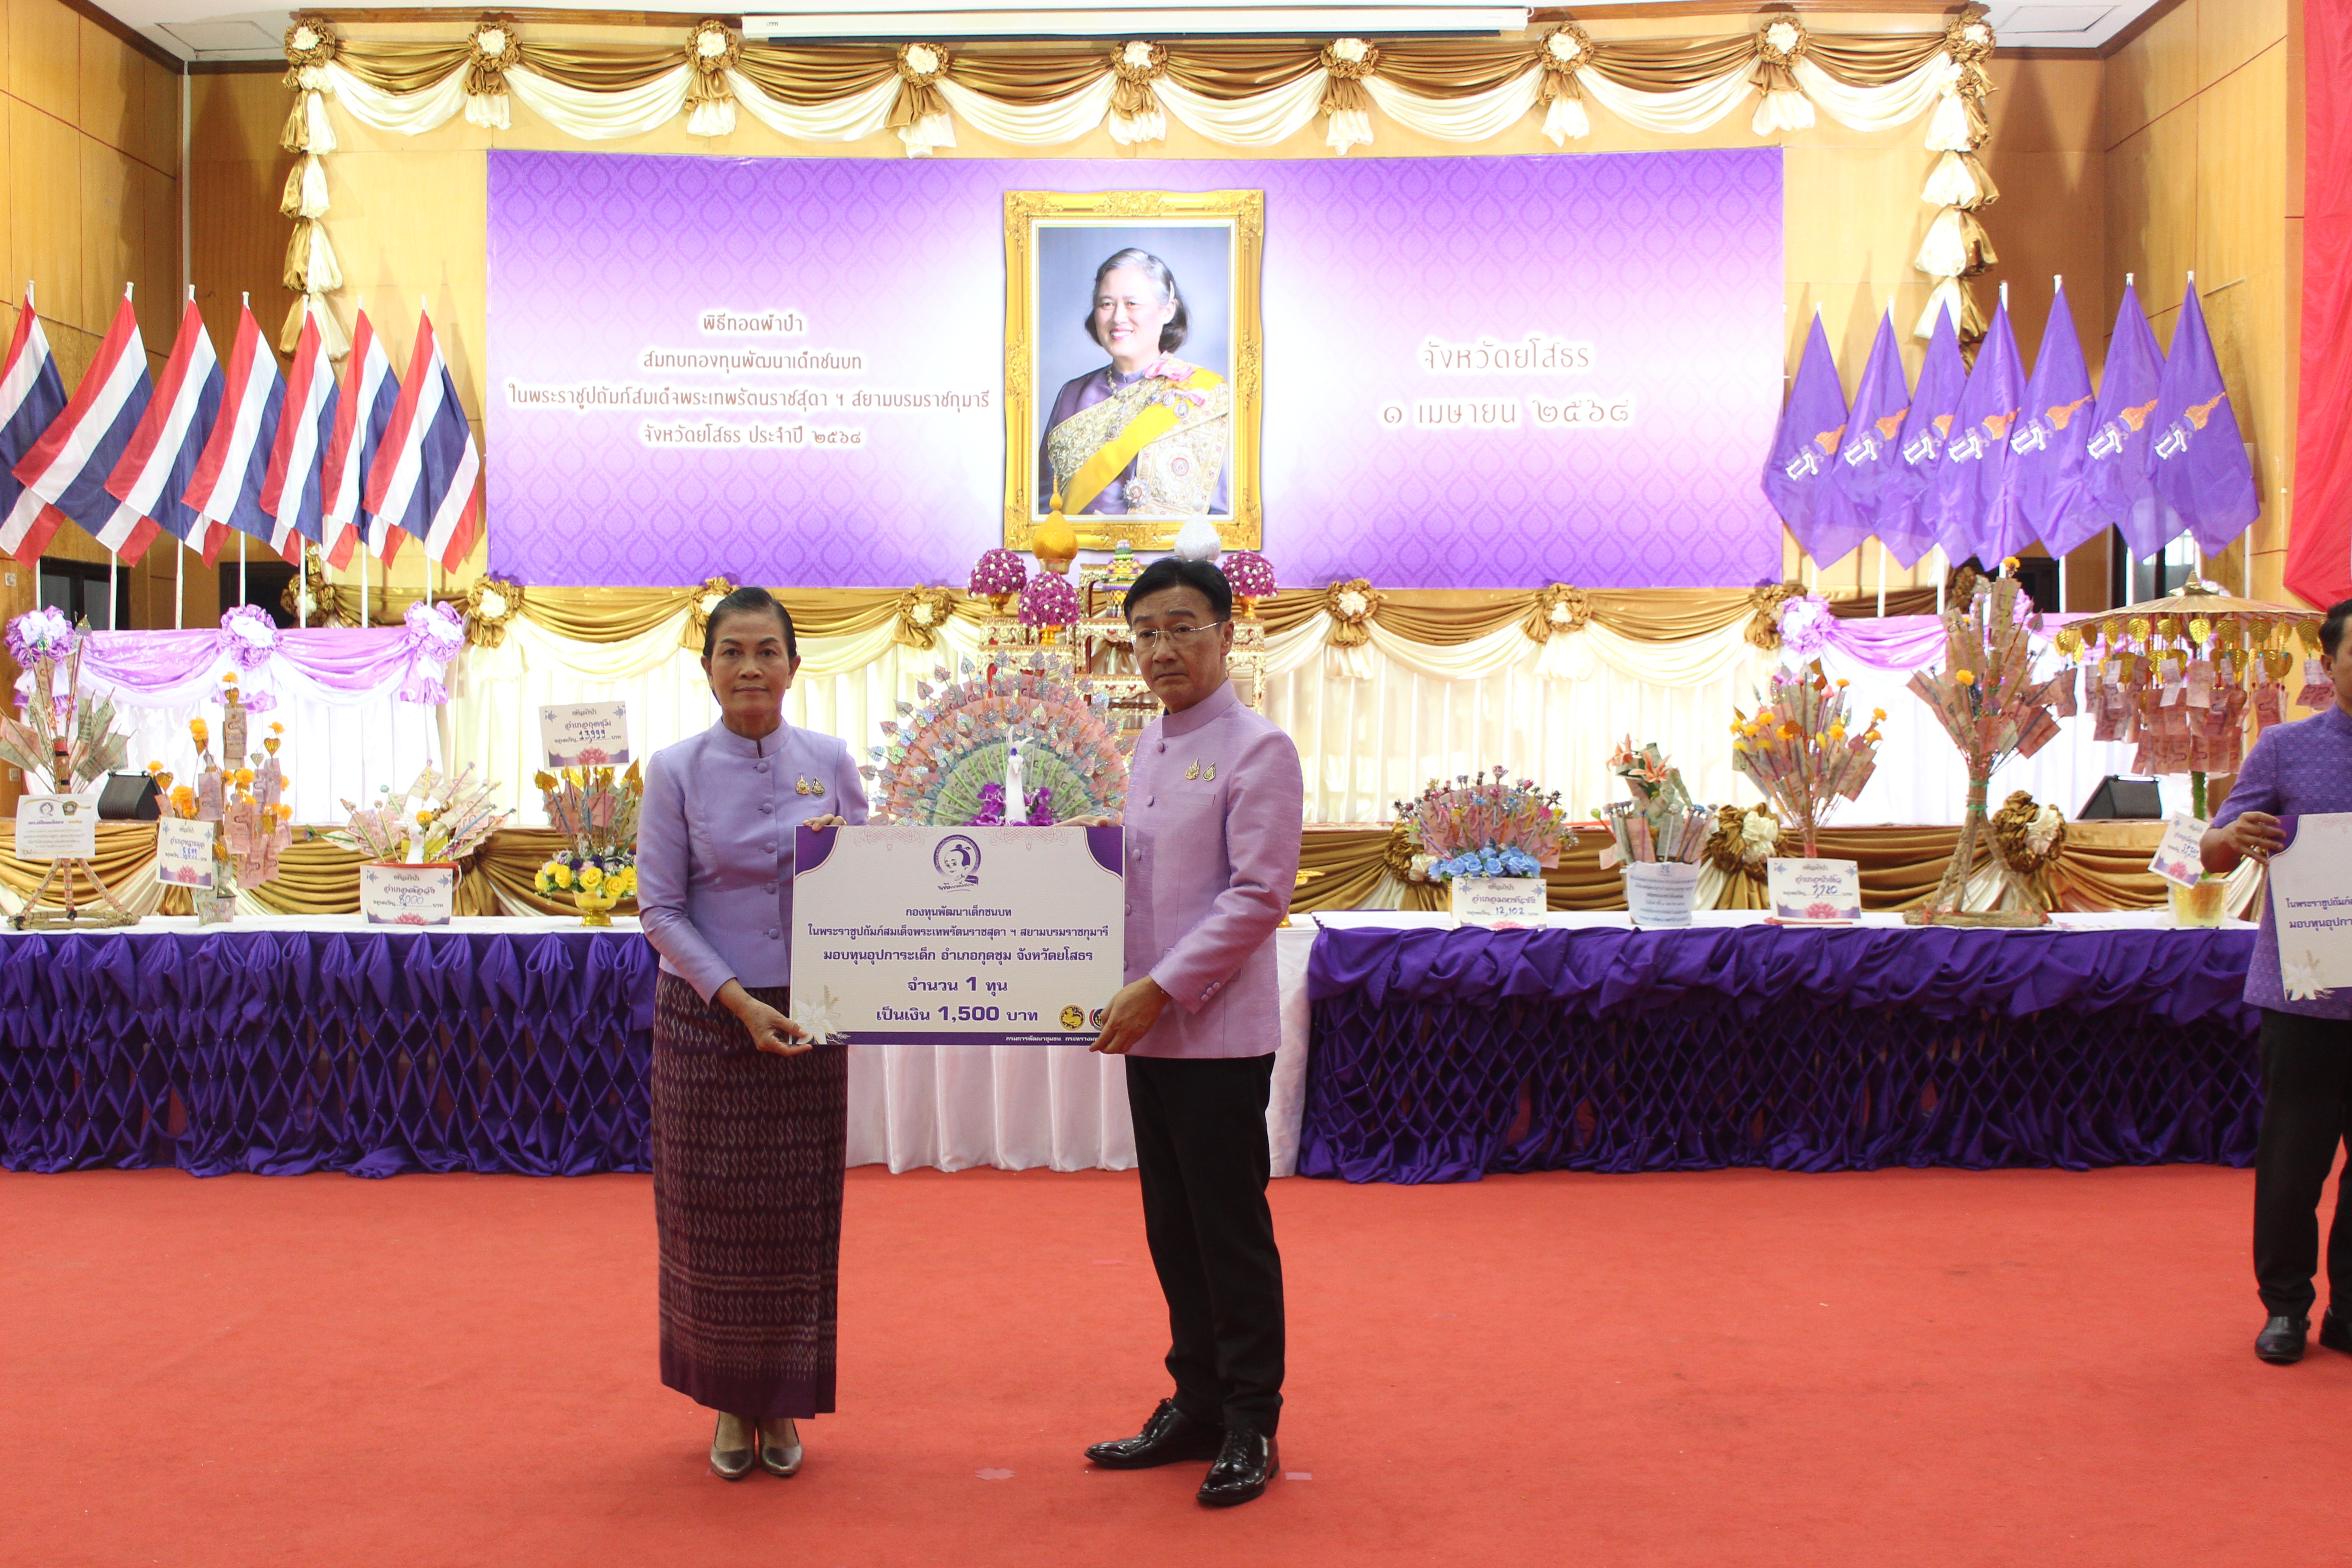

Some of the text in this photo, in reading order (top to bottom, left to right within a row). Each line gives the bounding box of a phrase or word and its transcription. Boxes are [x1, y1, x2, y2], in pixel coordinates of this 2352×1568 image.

[704, 314, 802, 331] พิธีทอดผ้าป่า
[644, 351, 861, 373] สมทบกองทุนพัฒนาเด็กชนบท
[1426, 338, 1588, 368] จังหวัดยโสธร
[509, 384, 827, 412] ในพระราชูปถัมภ์สมเด็จพระเทพรัตนราชสุดา
[853, 391, 989, 412] สยามบรมราชกุมารี
[1384, 401, 1628, 423] ๑ เมษายน ๒๕๖๘
[646, 424, 860, 443] จังหวัดยโสธร ประจำปี ๒๕๖๘
[579, 730, 606, 743] 13,999
[906, 905, 1011, 920] กองทุนพัฒนาเด็กชนบท
[808, 923, 1006, 940] ในพระราชูปถัมภ์สมเด็จพระเทพรัตนราชสุดา
[1021, 926, 1108, 941] สยามบรมราชกุมารี
[824, 946, 1092, 965] มอบทุนอุปการะเด็ก อำเภอกุดชุม จังหวัดยโสธร
[908, 977, 1007, 996] จำนวน 1 ทุน
[877, 1006, 1037, 1023] เป็นเงิน 1,500 บาท
